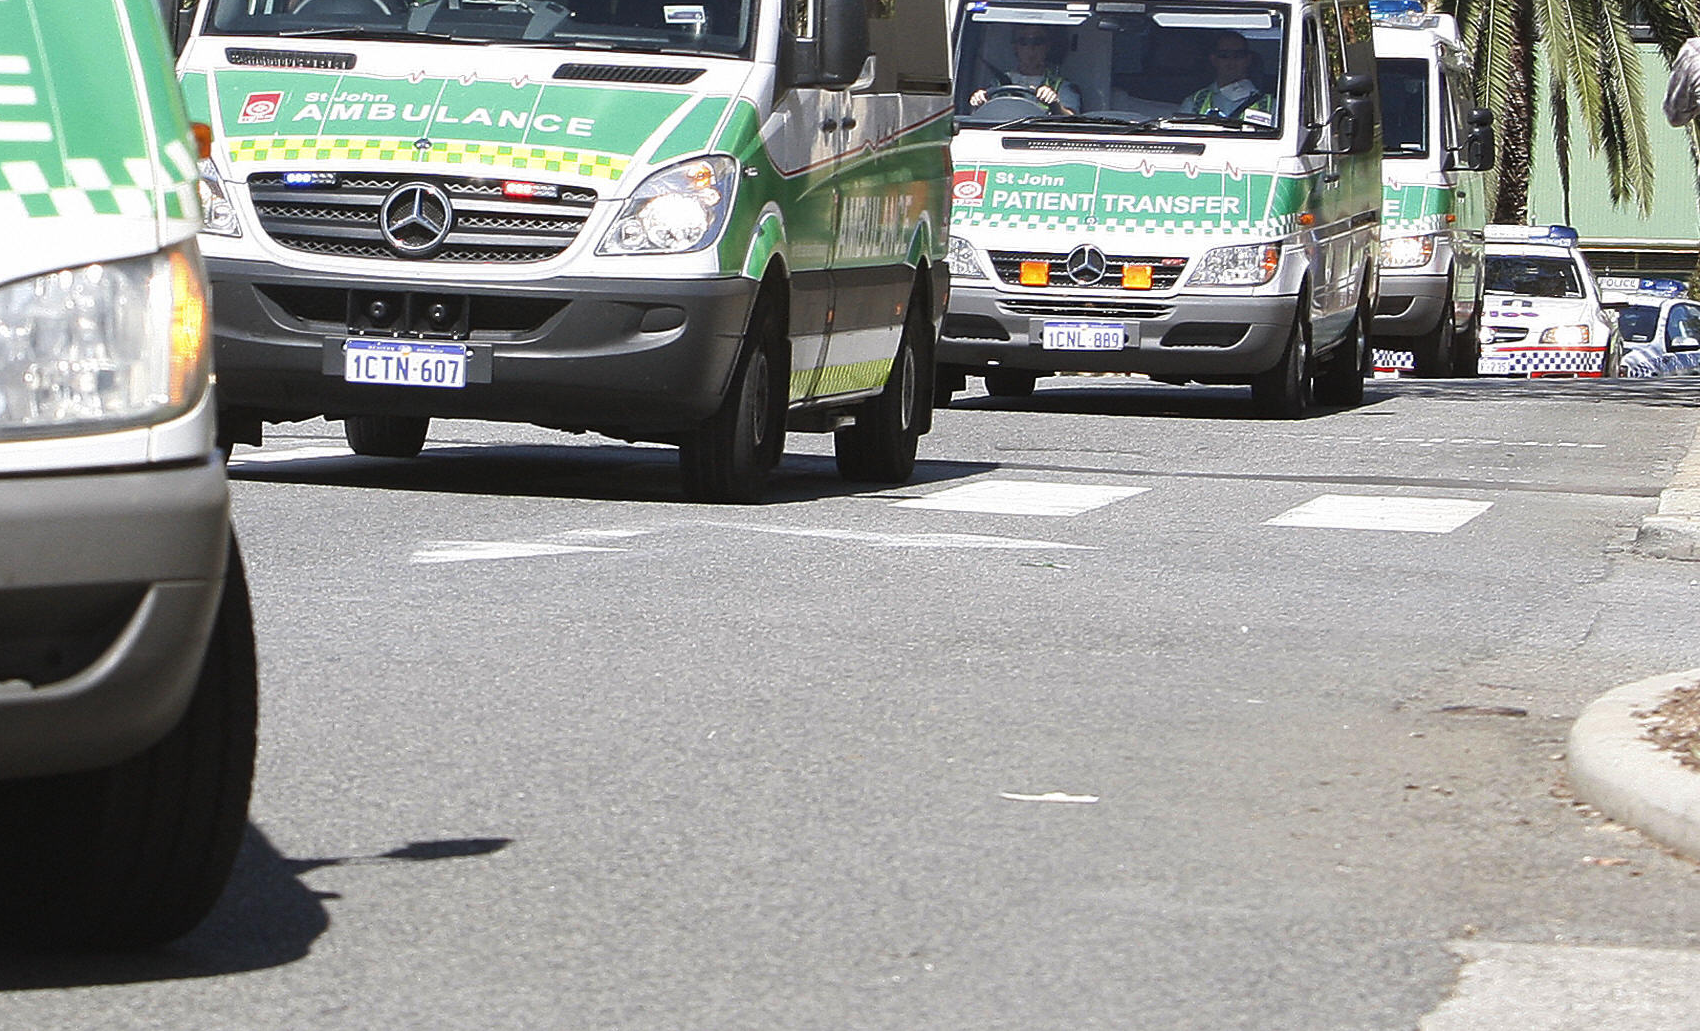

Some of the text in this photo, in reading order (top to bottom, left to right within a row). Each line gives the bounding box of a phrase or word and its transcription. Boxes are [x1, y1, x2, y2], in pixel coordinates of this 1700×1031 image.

[304, 91, 388, 103] St John
[291, 102, 596, 138] AMBULANCE
[994, 172, 1065, 187] St John
[991, 189, 1241, 215] PATIENT TRANSFER
